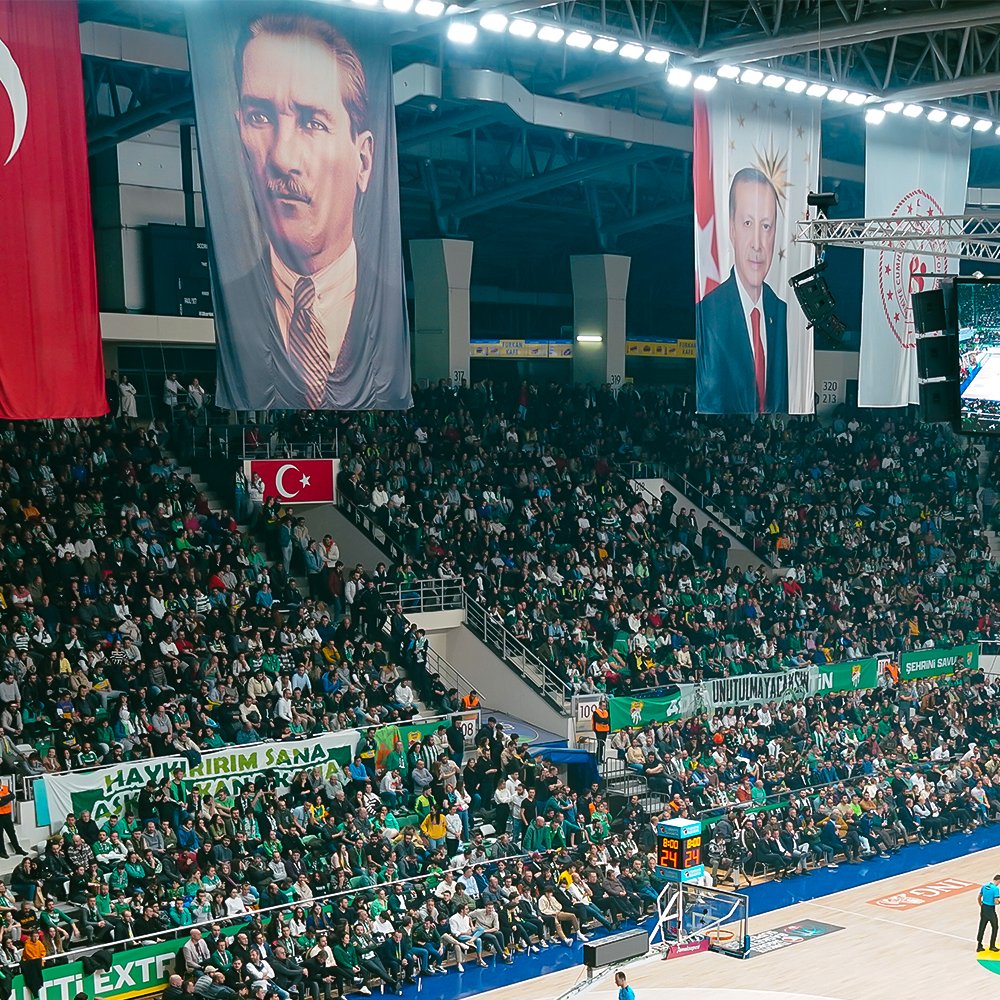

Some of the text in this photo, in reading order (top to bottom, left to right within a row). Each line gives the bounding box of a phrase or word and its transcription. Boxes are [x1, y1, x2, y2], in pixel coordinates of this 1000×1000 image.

[453, 371, 464, 381] 317
[610, 375, 621, 384] 319
[823, 381, 838, 391] 320
[822, 394, 837, 403] 213
[462, 723, 474, 736] 08
[265, 743, 326, 766] SANA
[663, 838, 678, 849] 8:00
[686, 837, 701, 849] 8:00
[660, 850, 677, 868] 24
[685, 849, 700, 868] 24
[914, 878, 975, 898] ING
